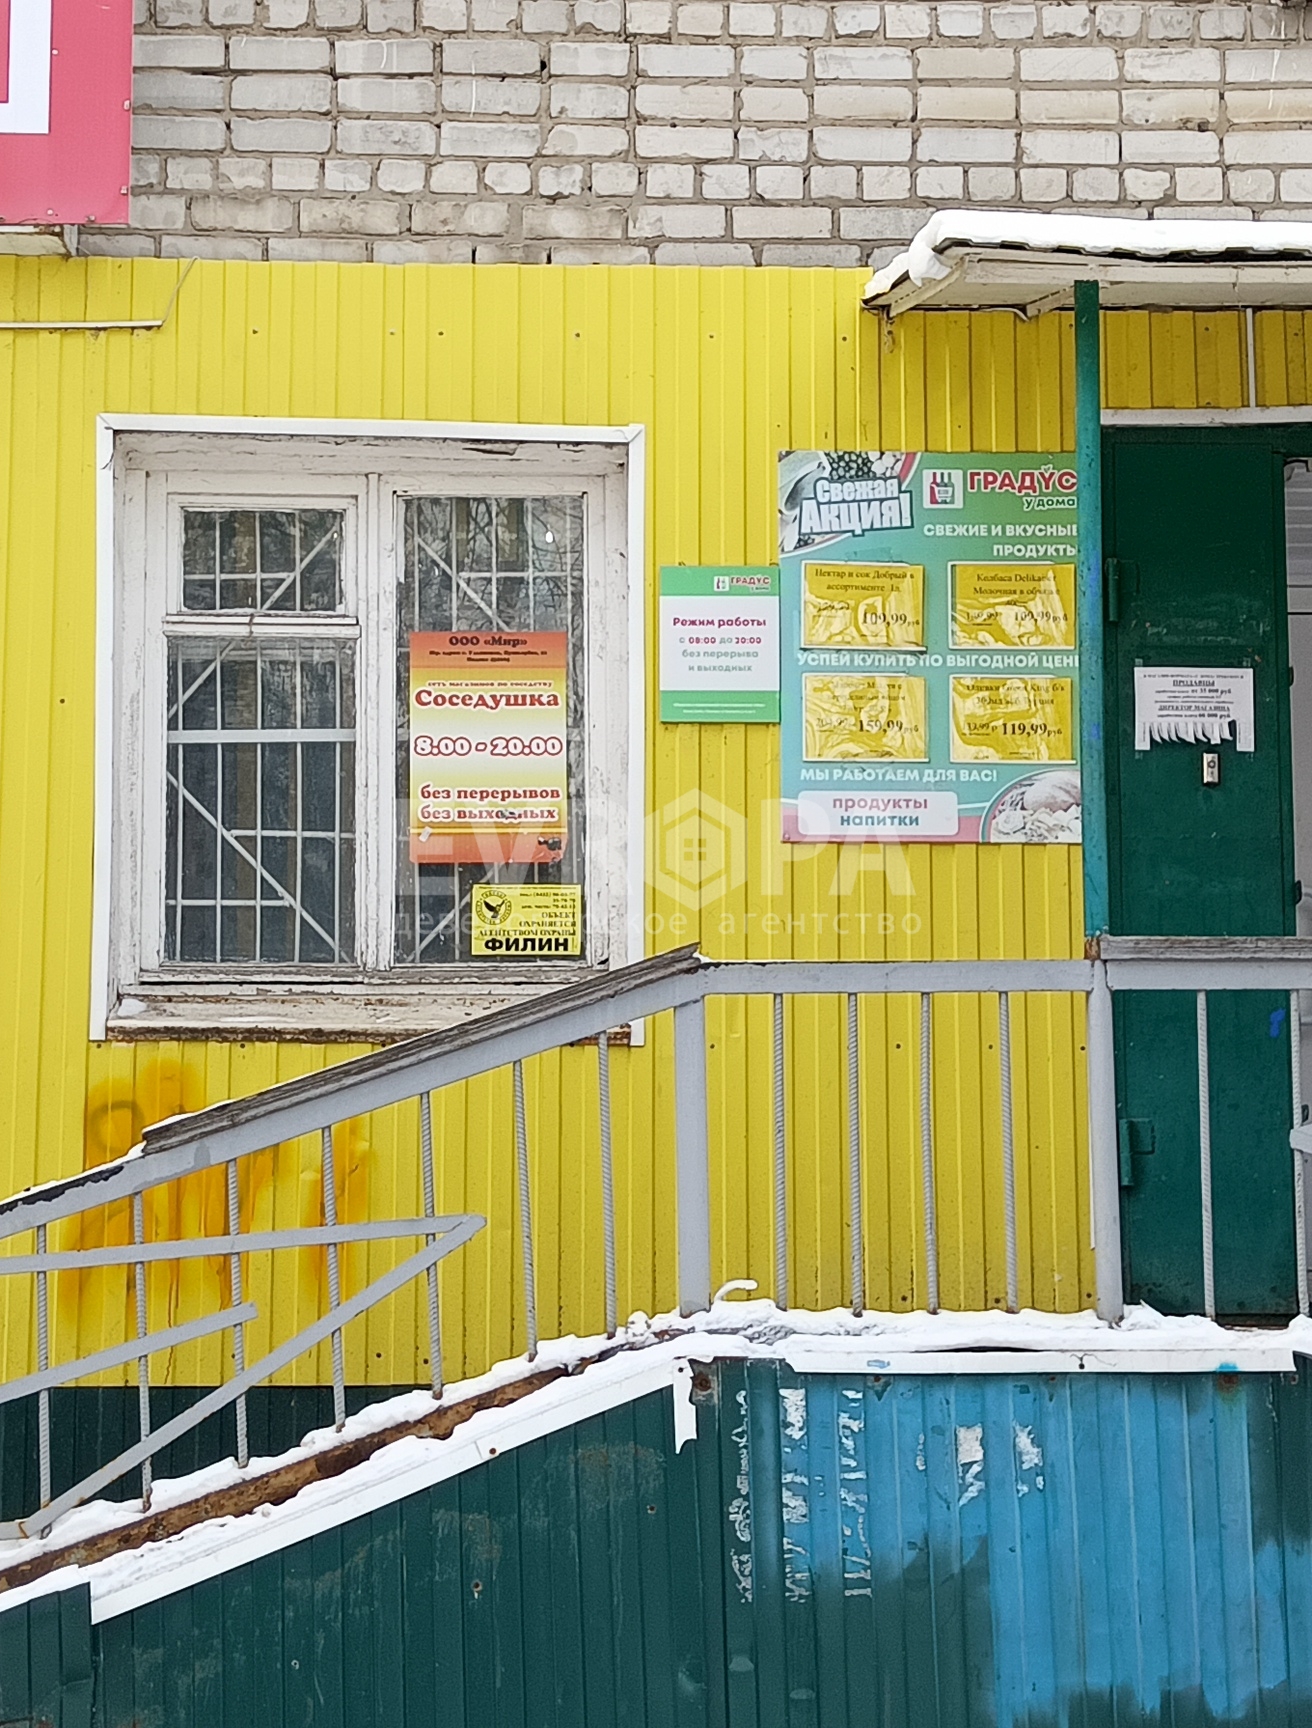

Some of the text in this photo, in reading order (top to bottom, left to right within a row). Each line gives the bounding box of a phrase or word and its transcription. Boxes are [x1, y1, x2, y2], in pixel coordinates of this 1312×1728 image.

[969, 470, 1077, 493] ГРАДУС
[815, 478, 899, 503] Свежая
[1036, 498, 1077, 508] дома
[923, 524, 988, 536] СВЕЖИЕ
[991, 524, 1002, 536] И
[730, 576, 770, 585] ГРАДУС
[826, 584, 886, 592] ассортименте
[673, 616, 767, 629] Режим работы
[448, 635, 480, 646] ООО
[719, 637, 733, 645] до
[682, 649, 759, 659] без перерыва
[797, 650, 851, 666] УСПЕЙ
[853, 653, 917, 667] КУПИТЬ
[919, 654, 943, 667] ПО
[946, 652, 1039, 669] ВЫГОДНОЙ
[697, 665, 753, 673] выходных
[414, 689, 560, 710] Соседушка
[413, 734, 473, 757] 8.00
[489, 735, 564, 757] 20.00
[800, 769, 997, 783] МЫ РАБОТАЕМ ДЛЯ ВАС!
[420, 784, 561, 802] без перерывов
[420, 804, 451, 819] без
[832, 798, 928, 812] продукты
[840, 815, 920, 827] напитки
[484, 937, 569, 952] ФИЛИН
